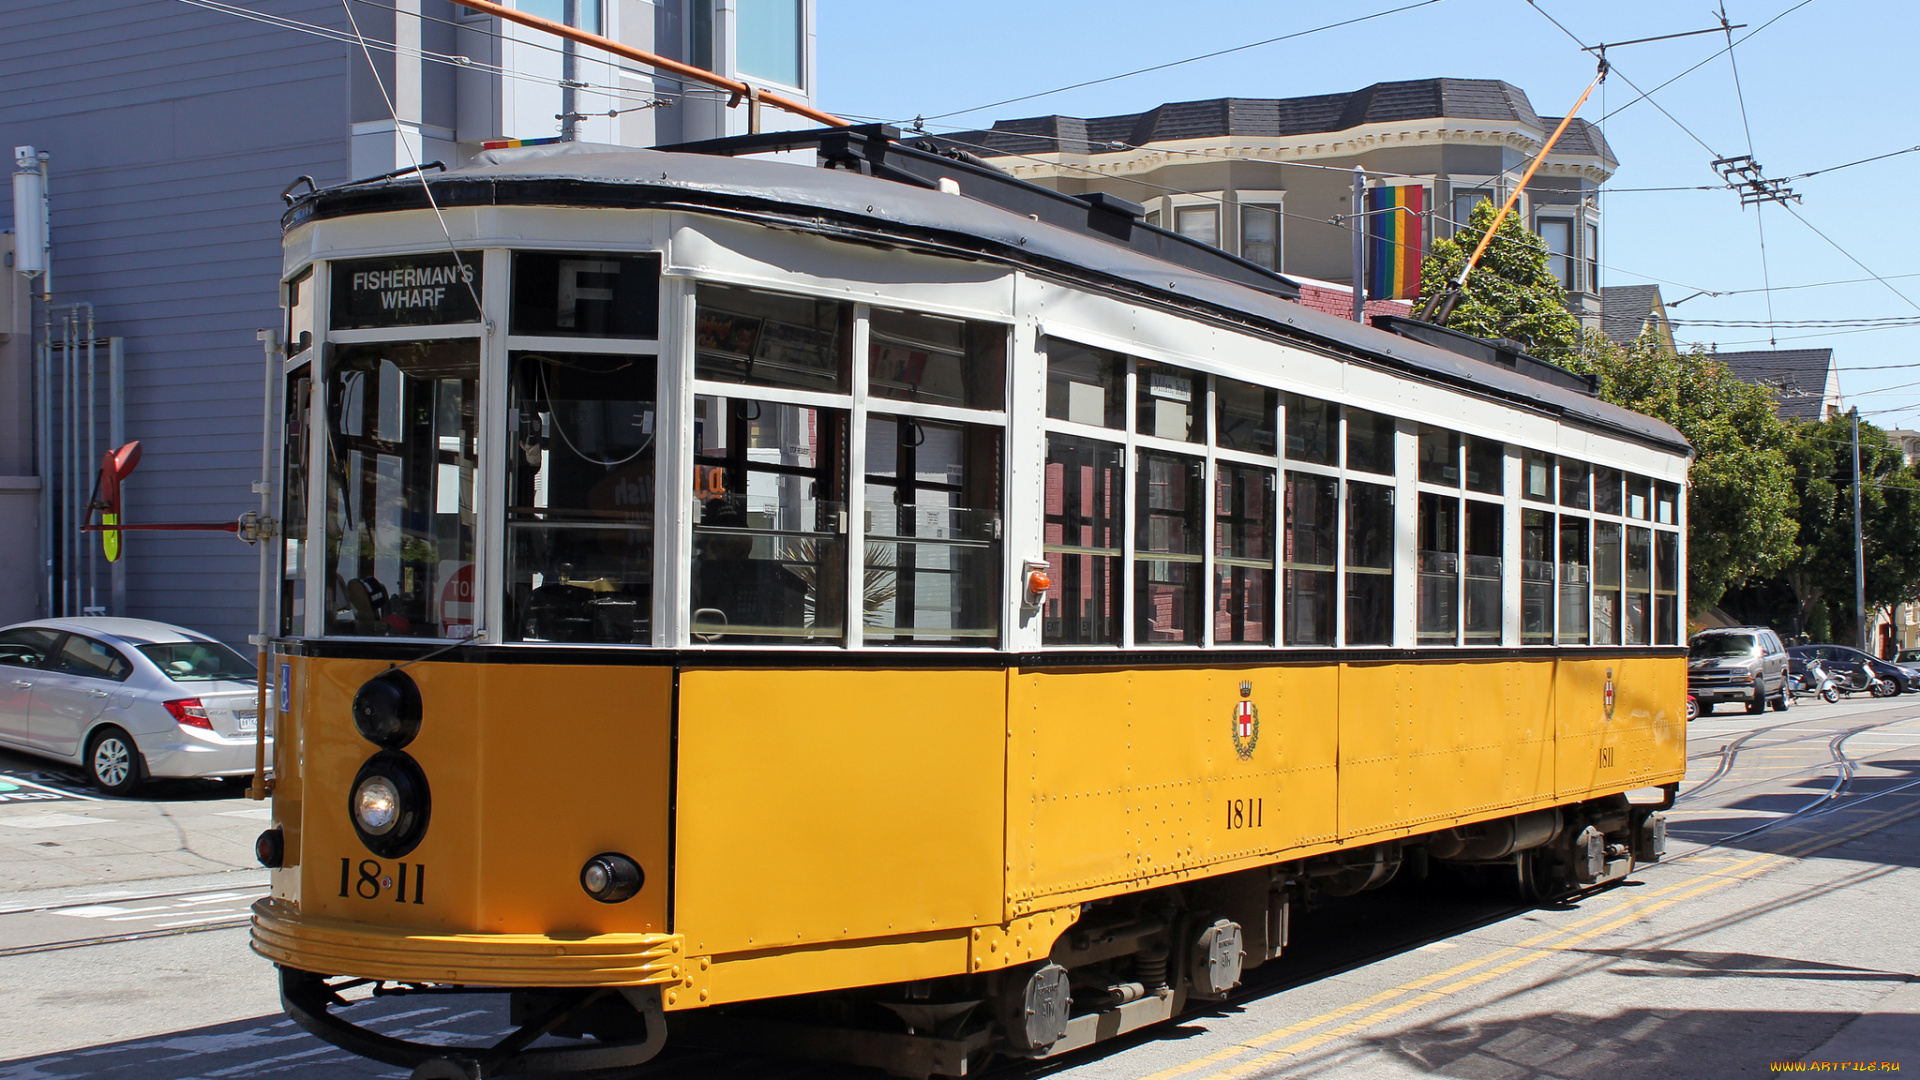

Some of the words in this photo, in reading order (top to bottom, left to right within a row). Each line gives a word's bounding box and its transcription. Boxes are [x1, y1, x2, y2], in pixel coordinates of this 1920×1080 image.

[353, 264, 474, 291] FISHERMAN'S
[381, 287, 446, 310] WHARF
[557, 259, 621, 327] F
[1046, 621, 1060, 632] EXIT
[1599, 747, 1614, 769] 1811
[1226, 797, 1262, 830] 1811
[338, 857, 425, 905] 1811
